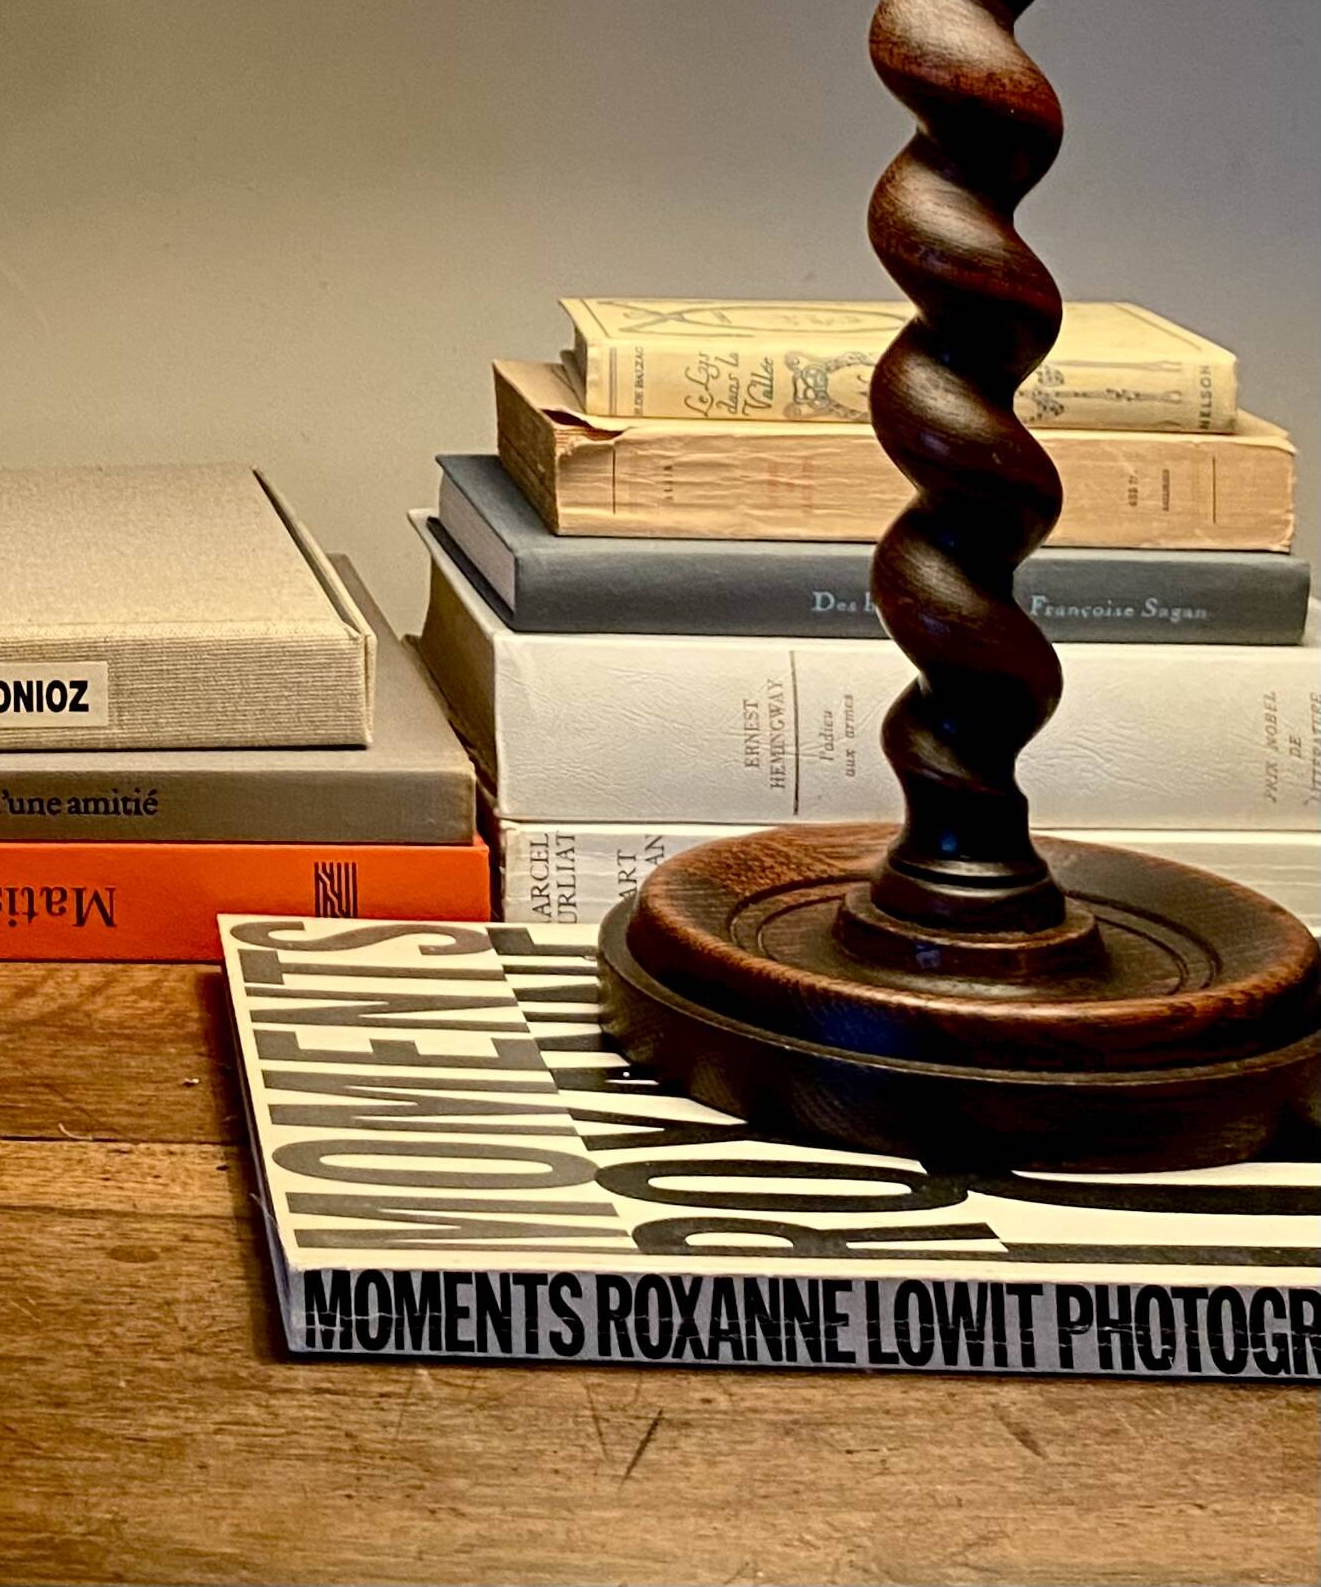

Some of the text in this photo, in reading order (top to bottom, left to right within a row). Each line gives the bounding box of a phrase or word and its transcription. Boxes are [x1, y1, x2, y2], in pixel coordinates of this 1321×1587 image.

[684, 352, 720, 416] Le Lys
[716, 352, 740, 415] dans la
[742, 356, 774, 417] Vallée
[1199, 364, 1212, 430] NELSON
[811, 591, 857, 612] Des
[1030, 595, 1207, 623] Françoise Sagan
[743, 699, 760, 769] ERNEST
[767, 678, 787, 790] HEMINGWAY
[819, 710, 835, 761] l'adieu
[844, 694, 856, 777] aux armes
[1263, 691, 1279, 803] PRIX NOBEL
[1289, 733, 1302, 759] DE
[66, 787, 159, 817] amitié
[530, 831, 552, 924] ARCEL
[555, 829, 578, 925] URLIAT
[230, 920, 639, 1255] MOMENTS
[303, 1269, 1321, 1376] MOMENTS ROXANNE LOWIT PHOTOGR
